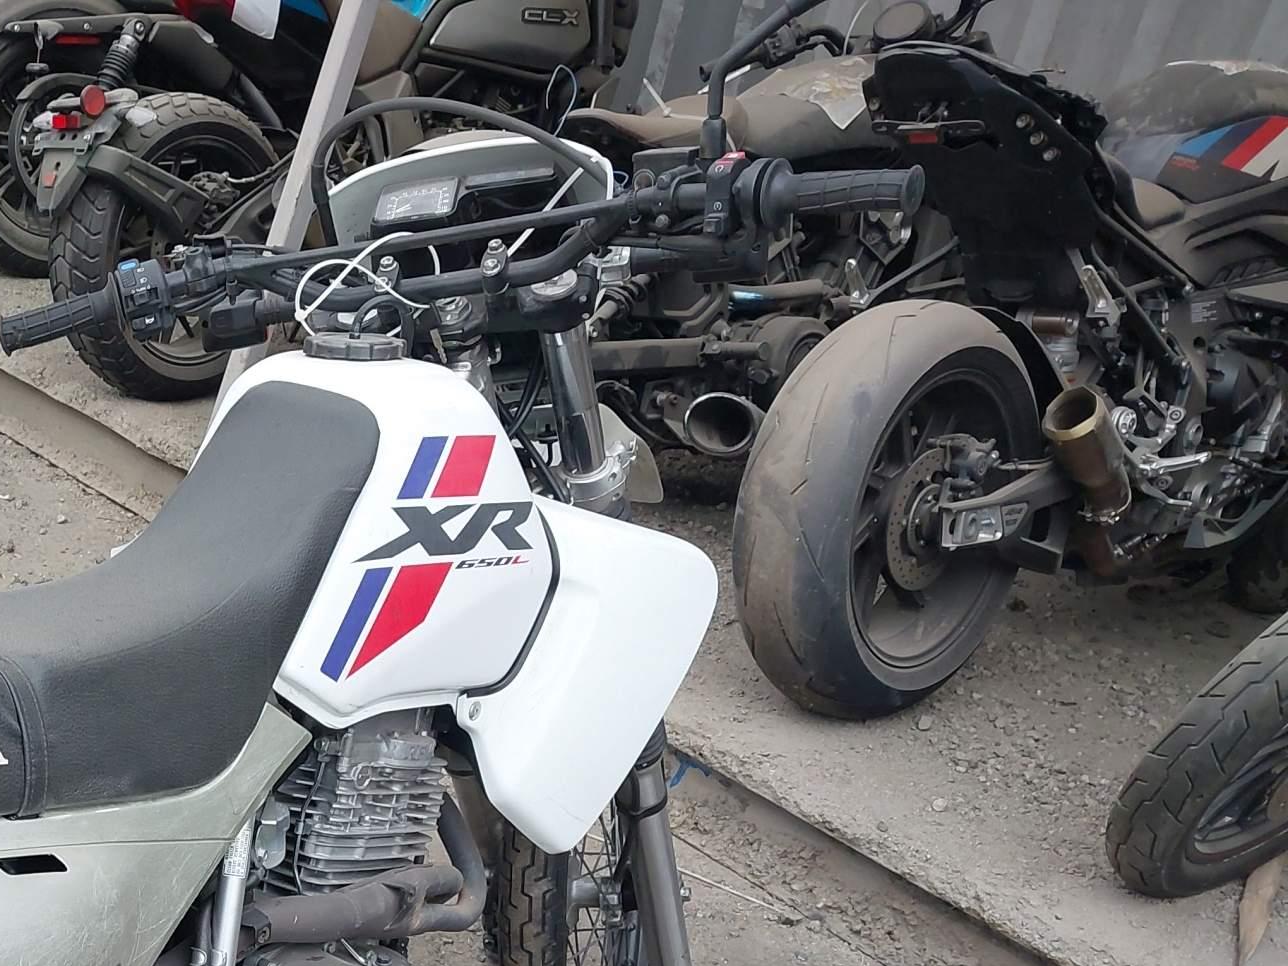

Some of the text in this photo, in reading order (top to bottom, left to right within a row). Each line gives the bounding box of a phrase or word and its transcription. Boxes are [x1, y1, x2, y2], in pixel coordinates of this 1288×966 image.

[524, 9, 579, 25] CLX
[350, 501, 534, 564] XR
[455, 555, 530, 570] 650L
